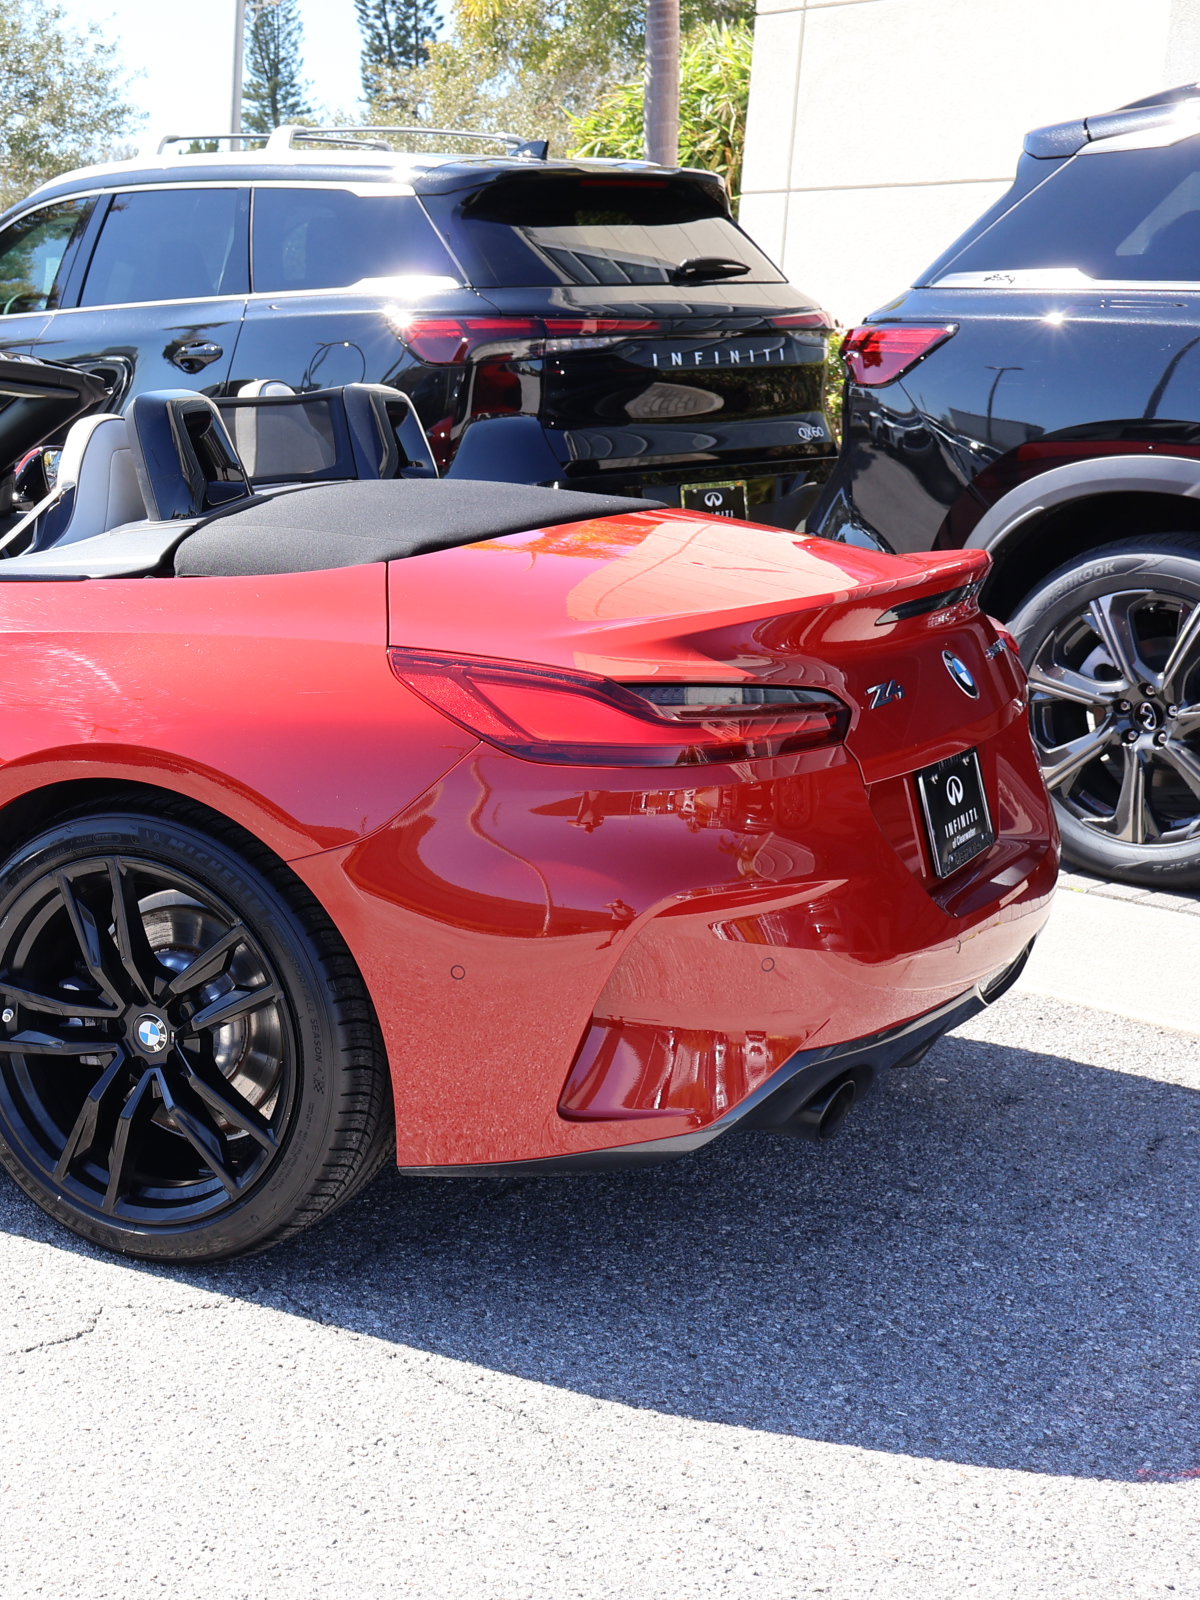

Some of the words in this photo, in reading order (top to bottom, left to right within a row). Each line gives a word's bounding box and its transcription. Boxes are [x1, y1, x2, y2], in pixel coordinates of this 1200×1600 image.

[653, 348, 784, 366] INFINITI
[798, 426, 824, 440] QX60
[866, 680, 906, 710] Z4
[944, 807, 978, 839] INFINITI
[310, 1018, 324, 1064] SEASON
